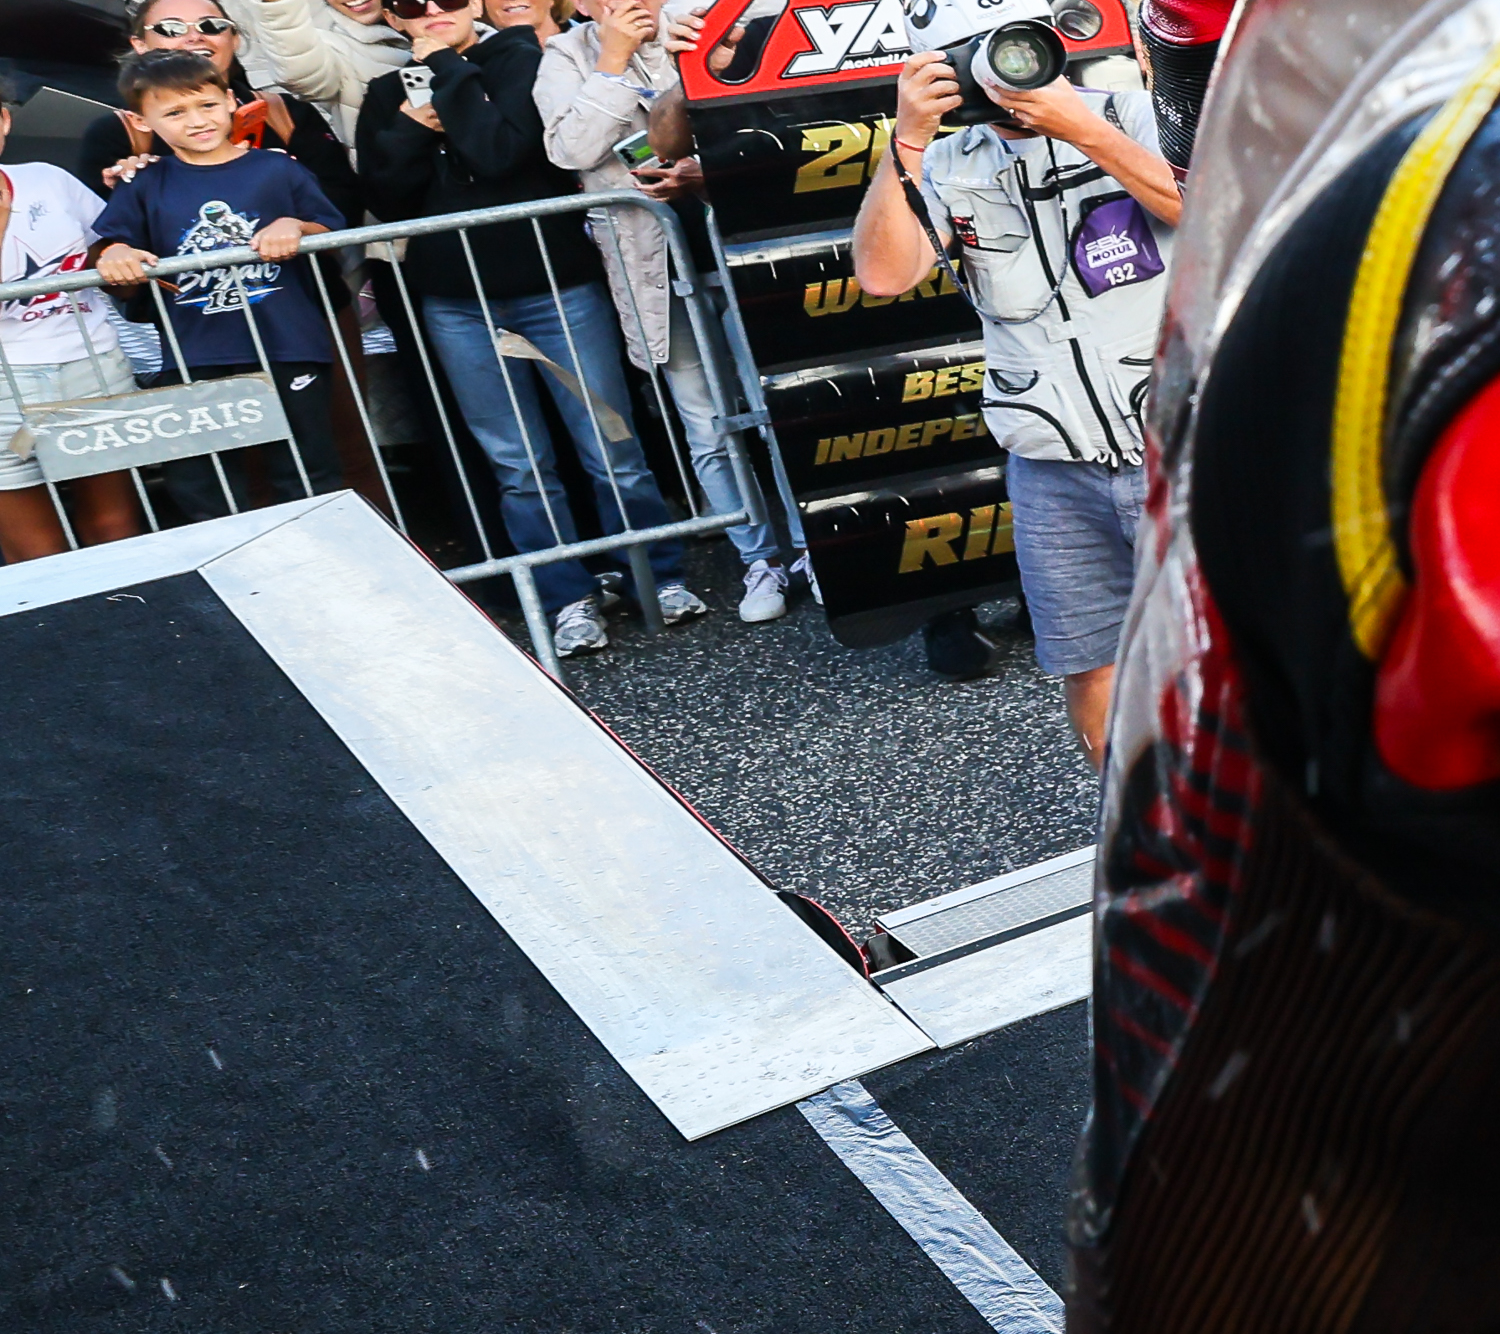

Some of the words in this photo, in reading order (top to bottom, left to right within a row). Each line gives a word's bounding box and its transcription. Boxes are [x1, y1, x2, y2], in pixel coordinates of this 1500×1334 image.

[1084, 225, 1131, 254] SBK
[1091, 244, 1133, 264] MOTUL
[1104, 262, 1138, 287] 132
[55, 398, 265, 456] CASCAIS
